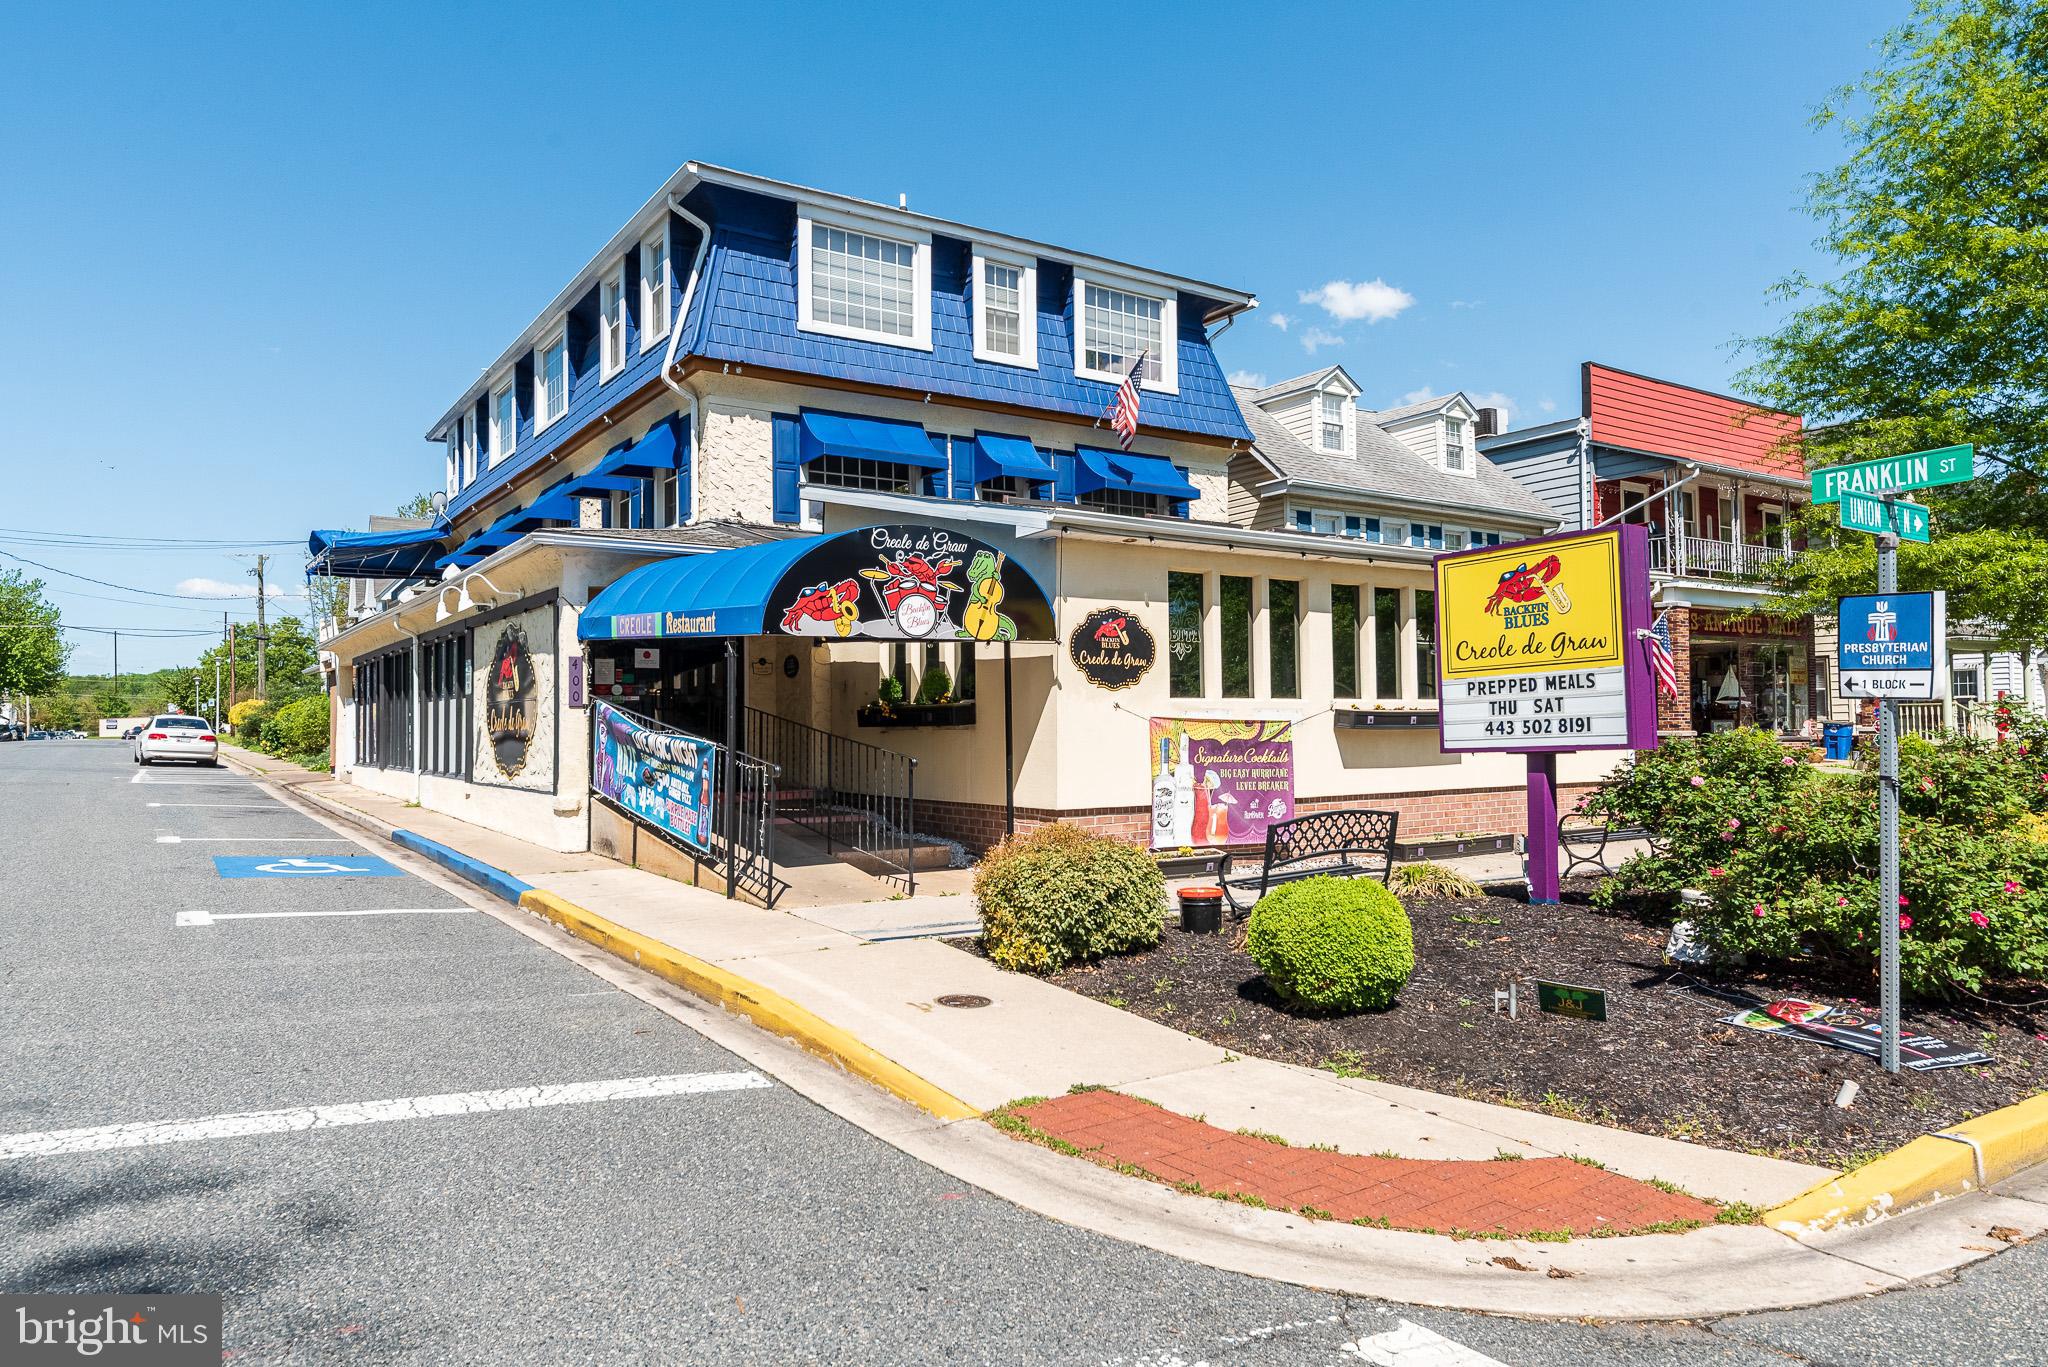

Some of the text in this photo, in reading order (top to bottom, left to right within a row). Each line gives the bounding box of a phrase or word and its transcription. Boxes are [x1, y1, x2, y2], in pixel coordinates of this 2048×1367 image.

[1825, 456, 1957, 498] FRANKLIN ST
[1849, 497, 1882, 529] UNION
[1903, 508, 1910, 534] N
[871, 528, 967, 557] Creole de Graw
[1503, 602, 1550, 617] BACKFIN
[619, 611, 717, 635] CREOLE Restaurant
[1504, 612, 1550, 630] BLUES
[1704, 614, 1763, 635] ANTIQUE
[1767, 615, 1801, 636] MALL
[1169, 629, 1201, 643] BITA
[1456, 632, 1608, 662] Creole de Graw
[1844, 642, 1928, 654] PRESBYTERIAN
[1080, 649, 1147, 669] Creole de Graw
[1861, 654, 1907, 665] CHURCH
[571, 658, 580, 702] 400
[1467, 673, 1596, 696] PREPPED MEALS
[1862, 680, 1906, 690] 1 BLOCK
[1489, 697, 1564, 716] THU SAT
[1485, 717, 1591, 736] 443 502 8191
[670, 739, 699, 769] NIGHT
[1194, 746, 1289, 766] Signature Cocktails
[1220, 768, 1289, 779] BIG EASY HURRICANE
[1236, 781, 1289, 792] LEVEE BREAKER
[669, 813, 691, 836] BOTTLES
[1558, 997, 1583, 1010] J&J
